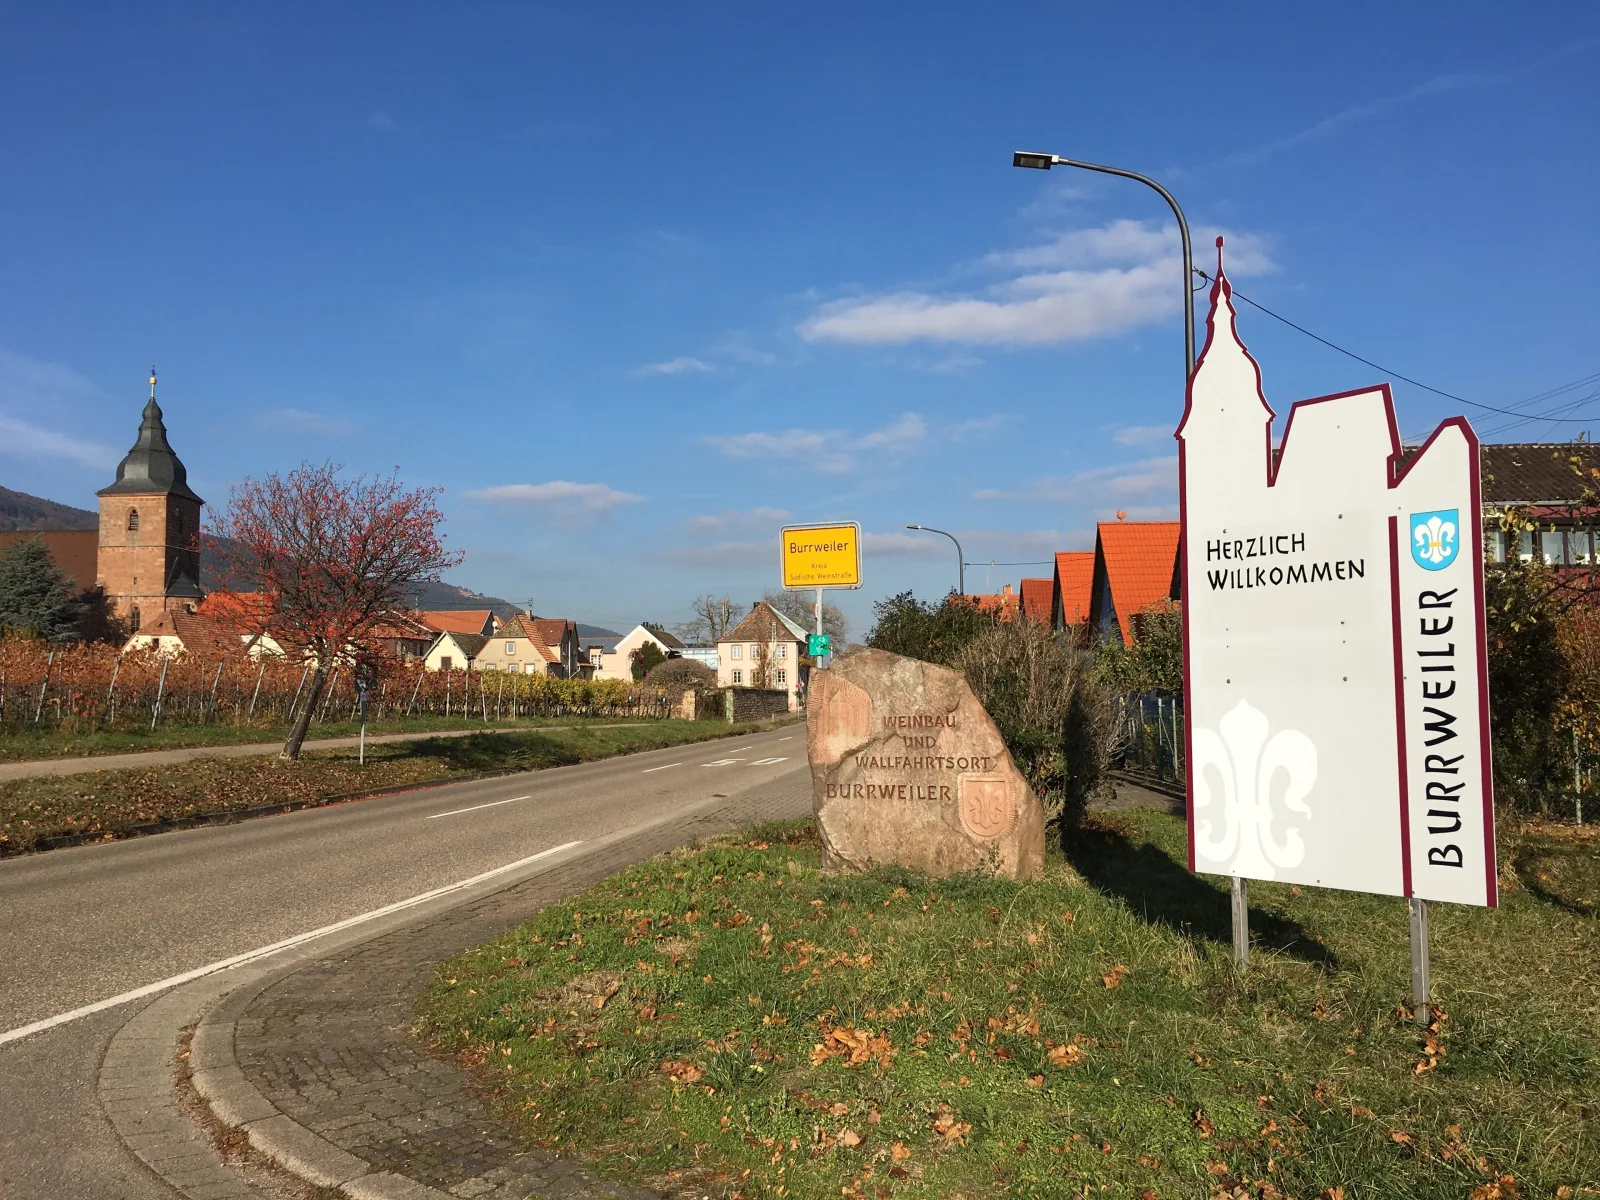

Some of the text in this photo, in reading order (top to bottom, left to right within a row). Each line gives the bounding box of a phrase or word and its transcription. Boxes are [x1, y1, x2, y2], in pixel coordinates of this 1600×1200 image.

[789, 541, 849, 553] Burrweiler
[1206, 532, 1306, 562] HERZLICH
[1206, 558, 1366, 591] WILLKOMMEN
[883, 715, 956, 728] WEINBAU
[1416, 587, 1466, 868] BURRWEILER
[903, 736, 936, 749] UND
[855, 756, 991, 769] WALLFAHRTSORT
[826, 783, 952, 800] BURRWEILER
